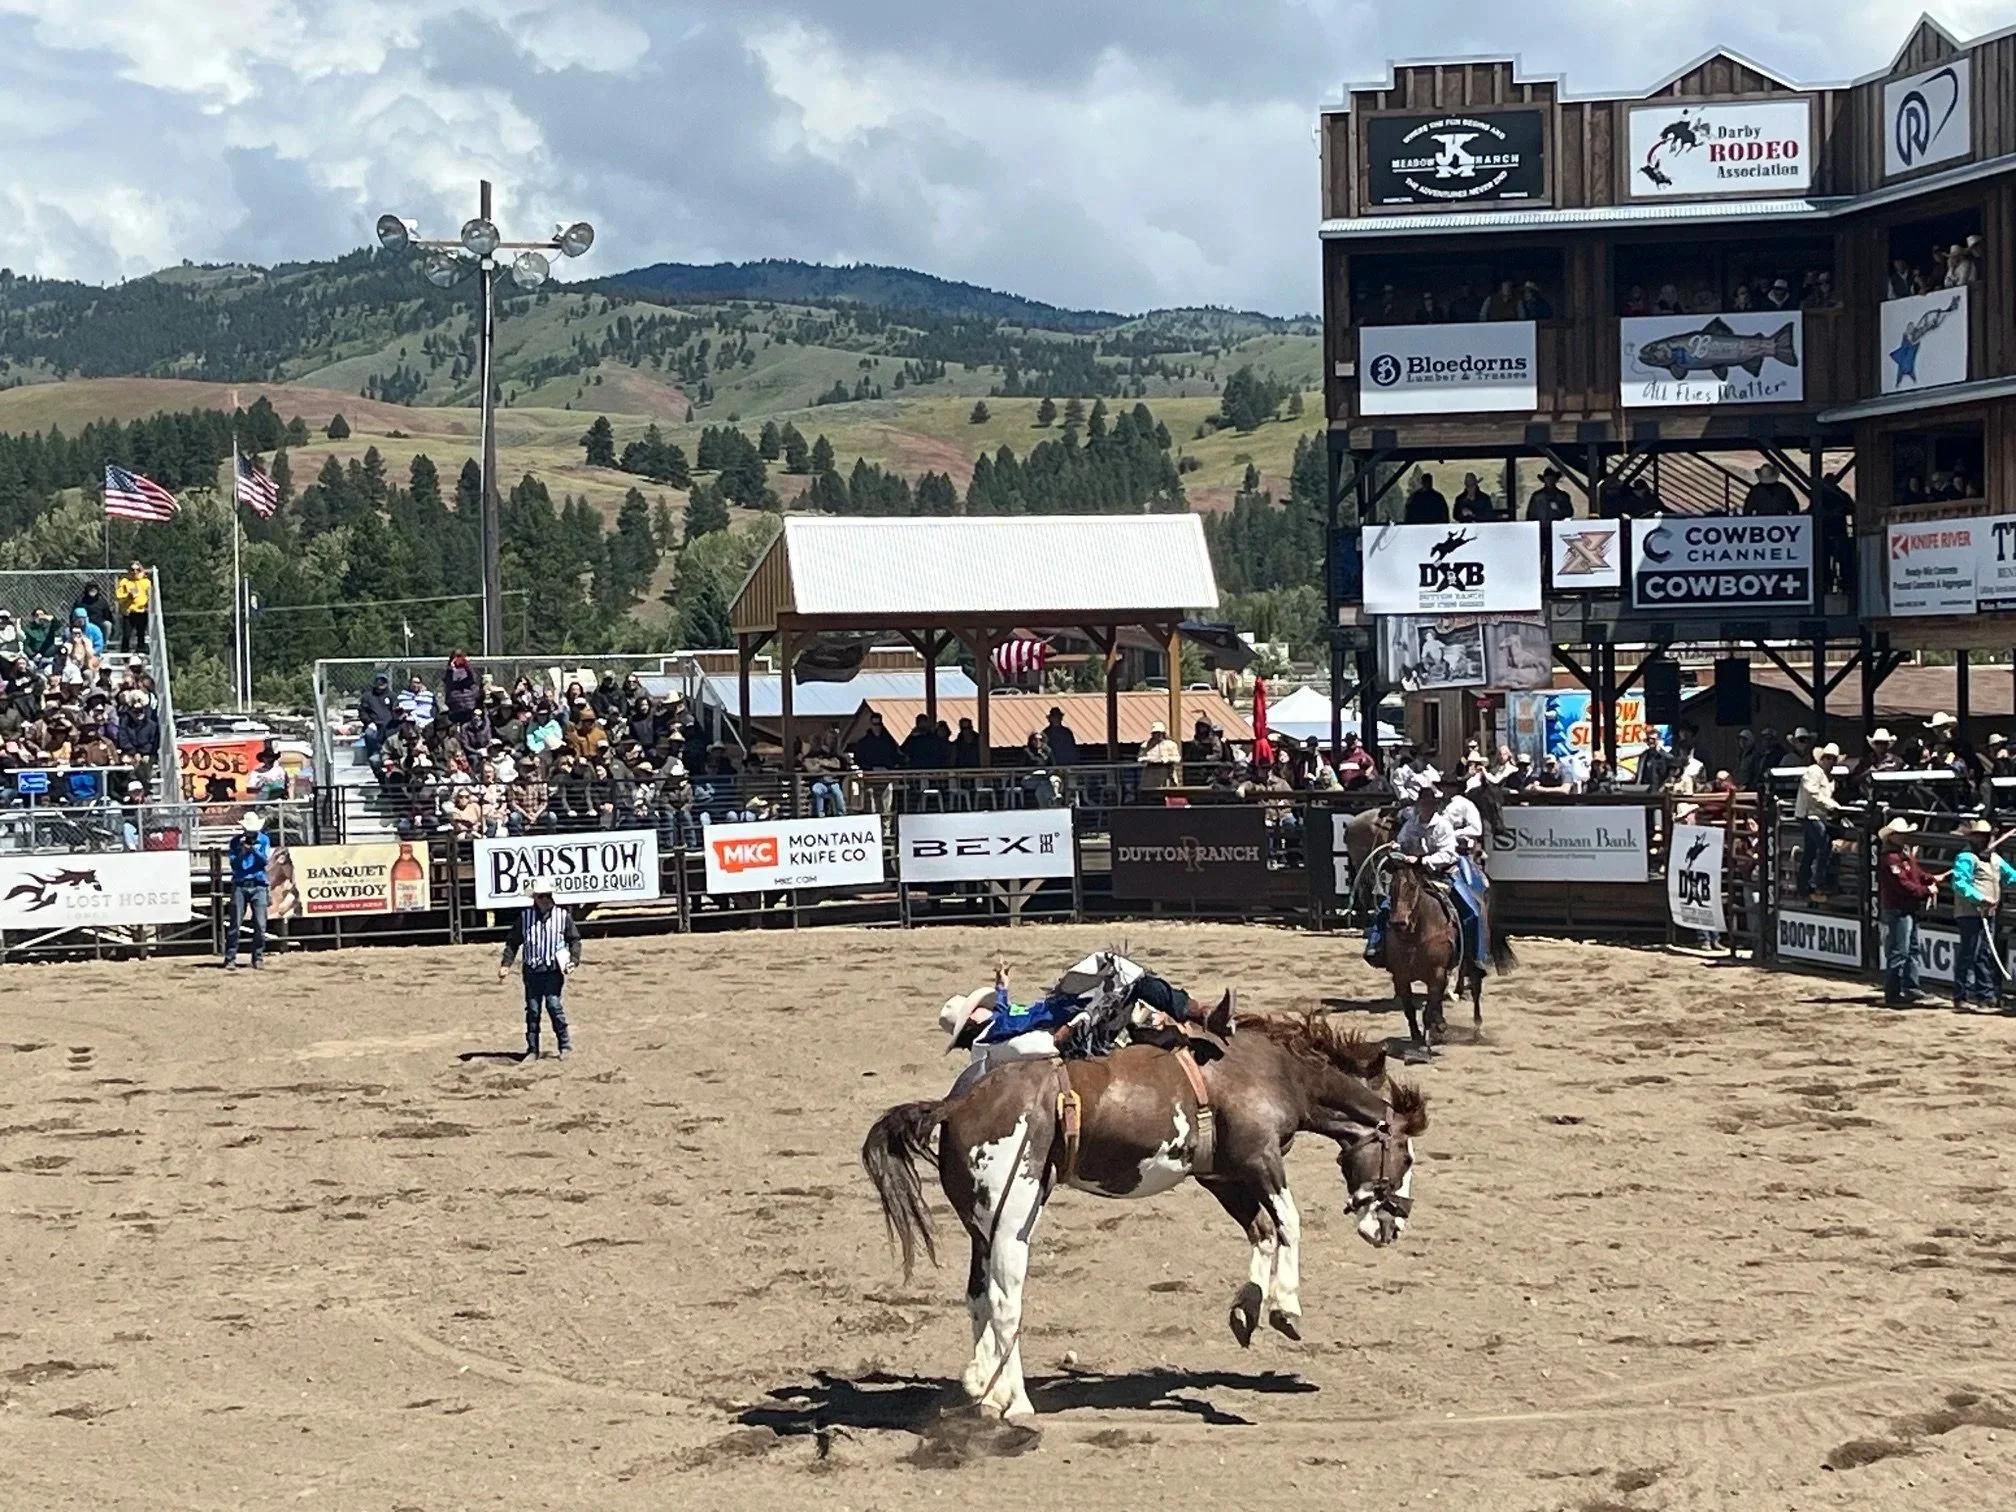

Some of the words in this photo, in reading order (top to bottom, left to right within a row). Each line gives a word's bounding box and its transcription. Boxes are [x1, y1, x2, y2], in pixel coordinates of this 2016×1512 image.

[1718, 125, 1762, 139] Darby
[1709, 140, 1799, 162] RODEO
[1391, 158, 1435, 168] MEADOW
[1475, 154, 1519, 164] RANCH
[1717, 164, 1799, 178] Association
[1406, 355, 1527, 374] Bloedorns
[1407, 373, 1456, 383] Lumber
[1643, 380, 1667, 400] All
[1676, 383, 1711, 401] Flies
[1685, 526, 1801, 545] COWBOY
[1910, 533, 1938, 550] KNIFE
[1941, 531, 1971, 548] RIVER
[1687, 548, 1798, 562] CHANNEL
[1645, 574, 1801, 599] COWBOY+
[789, 831, 876, 848] MONTANA
[1518, 828, 1591, 847] Stockman
[1596, 827, 1637, 847] Bank
[723, 842, 773, 865] MKC
[912, 835, 1034, 858] BEX
[1118, 847, 1189, 861] DUTTON
[1195, 846, 1260, 861] RANCH
[790, 850, 837, 865] KNIFE
[307, 865, 387, 879] BANQUET
[492, 843, 638, 894] BARSTOW
[307, 884, 387, 899] COWBOY
[555, 875, 598, 891] RODEO
[66, 894, 112, 908] LOST
[119, 892, 180, 906] HORSE
[1780, 920, 1816, 950] BOOT
[1818, 925, 1857, 957] BARN
